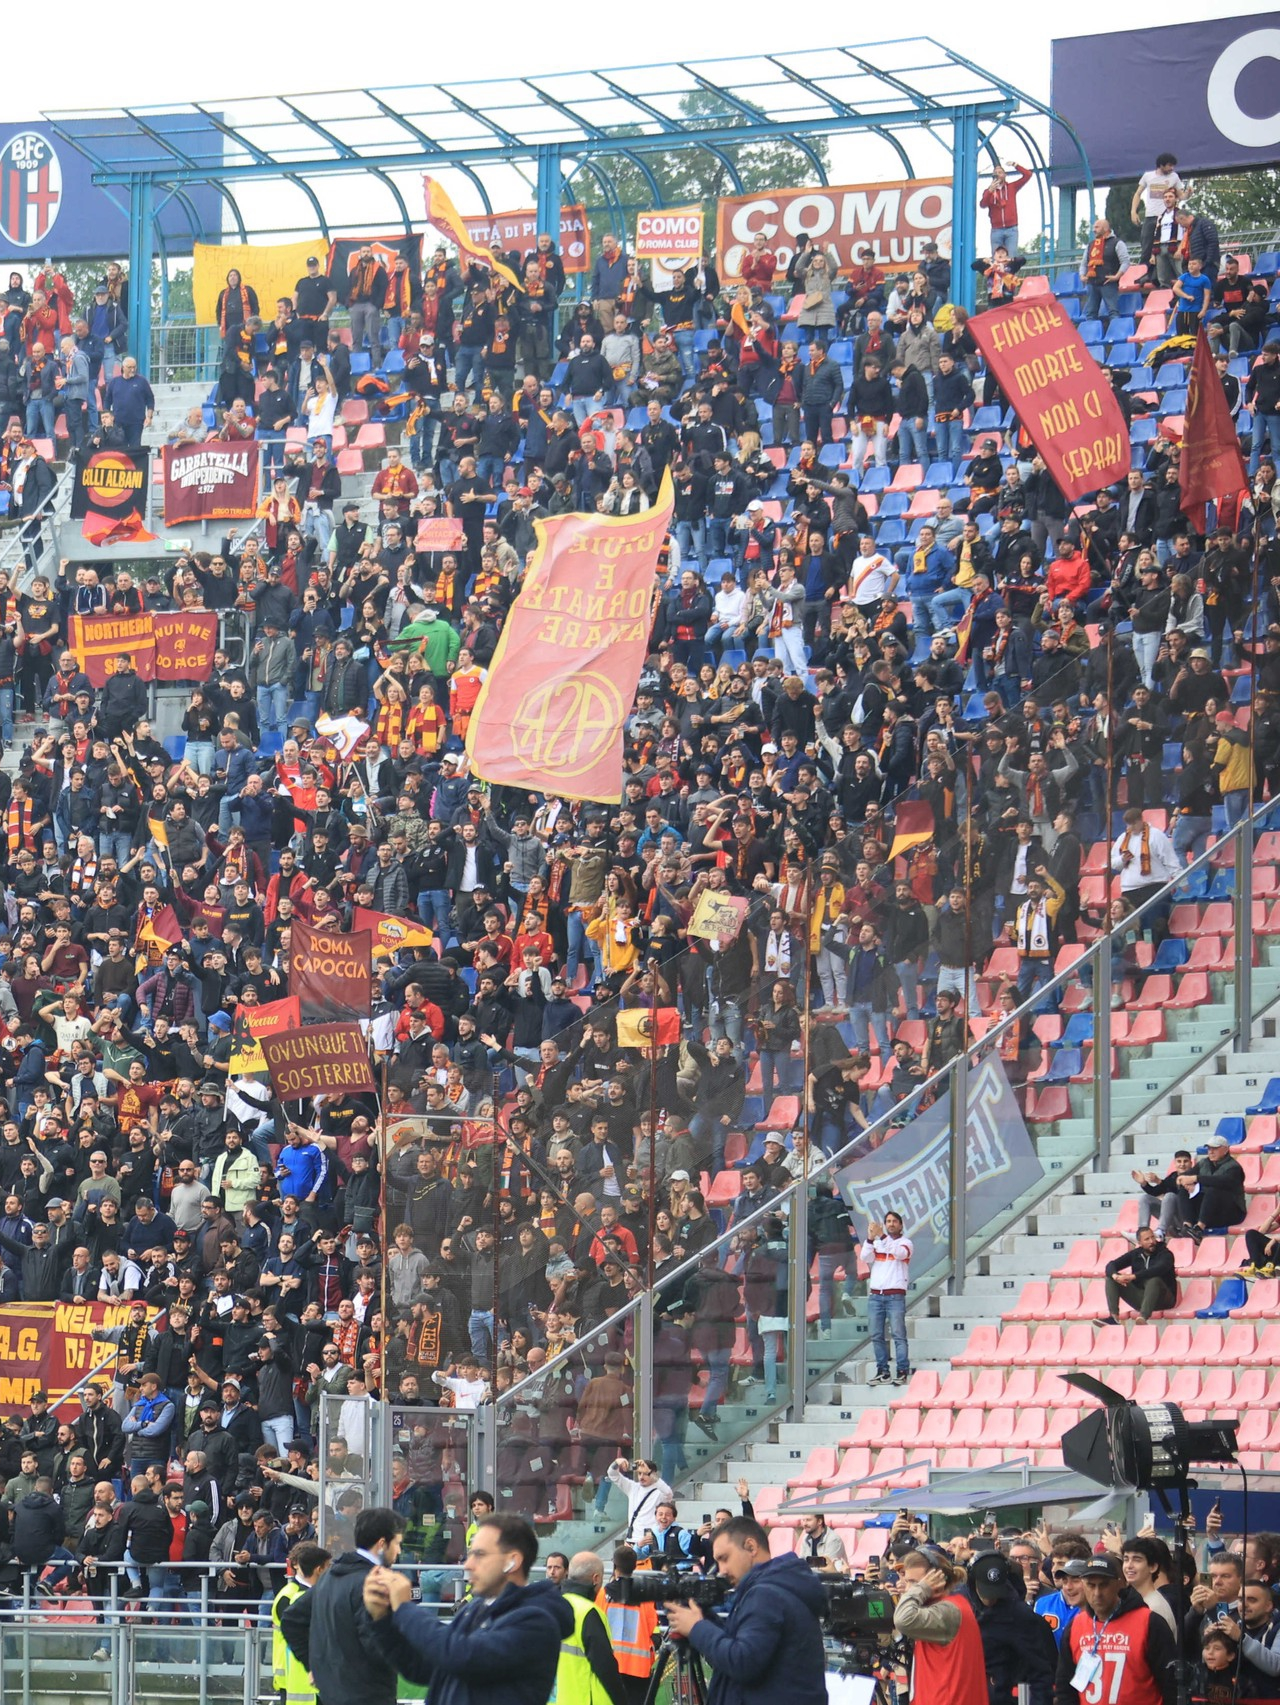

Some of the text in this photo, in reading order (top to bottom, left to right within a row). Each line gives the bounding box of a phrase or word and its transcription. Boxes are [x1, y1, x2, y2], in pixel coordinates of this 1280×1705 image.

[11, 136, 45, 161] BFC
[16, 159, 39, 169] 1909
[638, 216, 700, 235] COMO
[731, 185, 953, 244] COMO
[468, 225, 502, 242] ITTÀ
[505, 226, 519, 238] DI
[645, 239, 699, 249] ROMA CLUB
[850, 235, 932, 266] CLUB
[990, 304, 1064, 353] FINCHE
[1014, 344, 1084, 397] MORTE
[1038, 389, 1104, 441] NON CI
[171, 452, 249, 482] GARBATELLA
[1062, 433, 1123, 484] SEPARI
[82, 468, 144, 489] COLLI ALBANI
[84, 616, 153, 642] NORTHERN
[154, 623, 212, 641] NUN ME
[156, 654, 208, 670] DO PACE
[310, 935, 354, 956] ROMA
[293, 954, 368, 979] CAPOCCIA
[270, 1031, 365, 1064] OVUNQUE TI
[55, 1305, 97, 1335] NEL
[393, 1415, 402, 1426] 25
